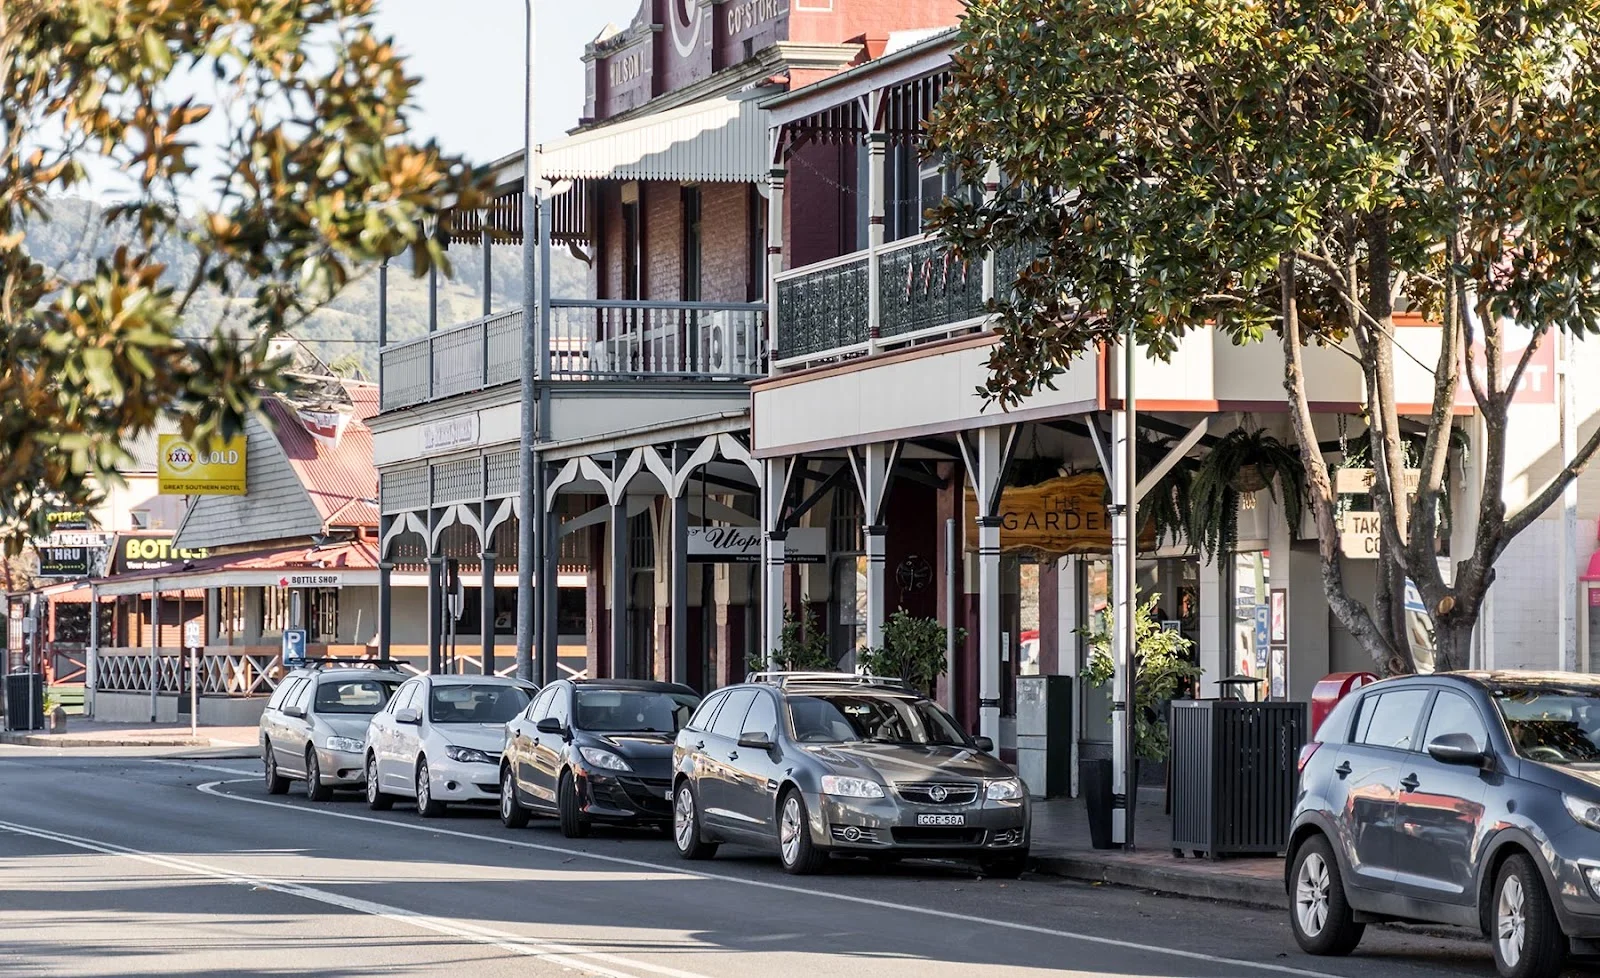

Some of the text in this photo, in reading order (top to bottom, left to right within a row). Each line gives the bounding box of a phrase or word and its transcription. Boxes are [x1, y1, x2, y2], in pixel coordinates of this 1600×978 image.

[610, 52, 639, 87] WILSON
[167, 450, 239, 465] XXXX GOLD
[1040, 495, 1082, 511] THE
[1353, 517, 1380, 534] TAK
[62, 534, 104, 545] MOTEL
[705, 527, 762, 553] Utopi
[46, 548, 80, 560] THRU
[292, 576, 338, 584] BOTTLE SHOP
[288, 632, 301, 649] P
